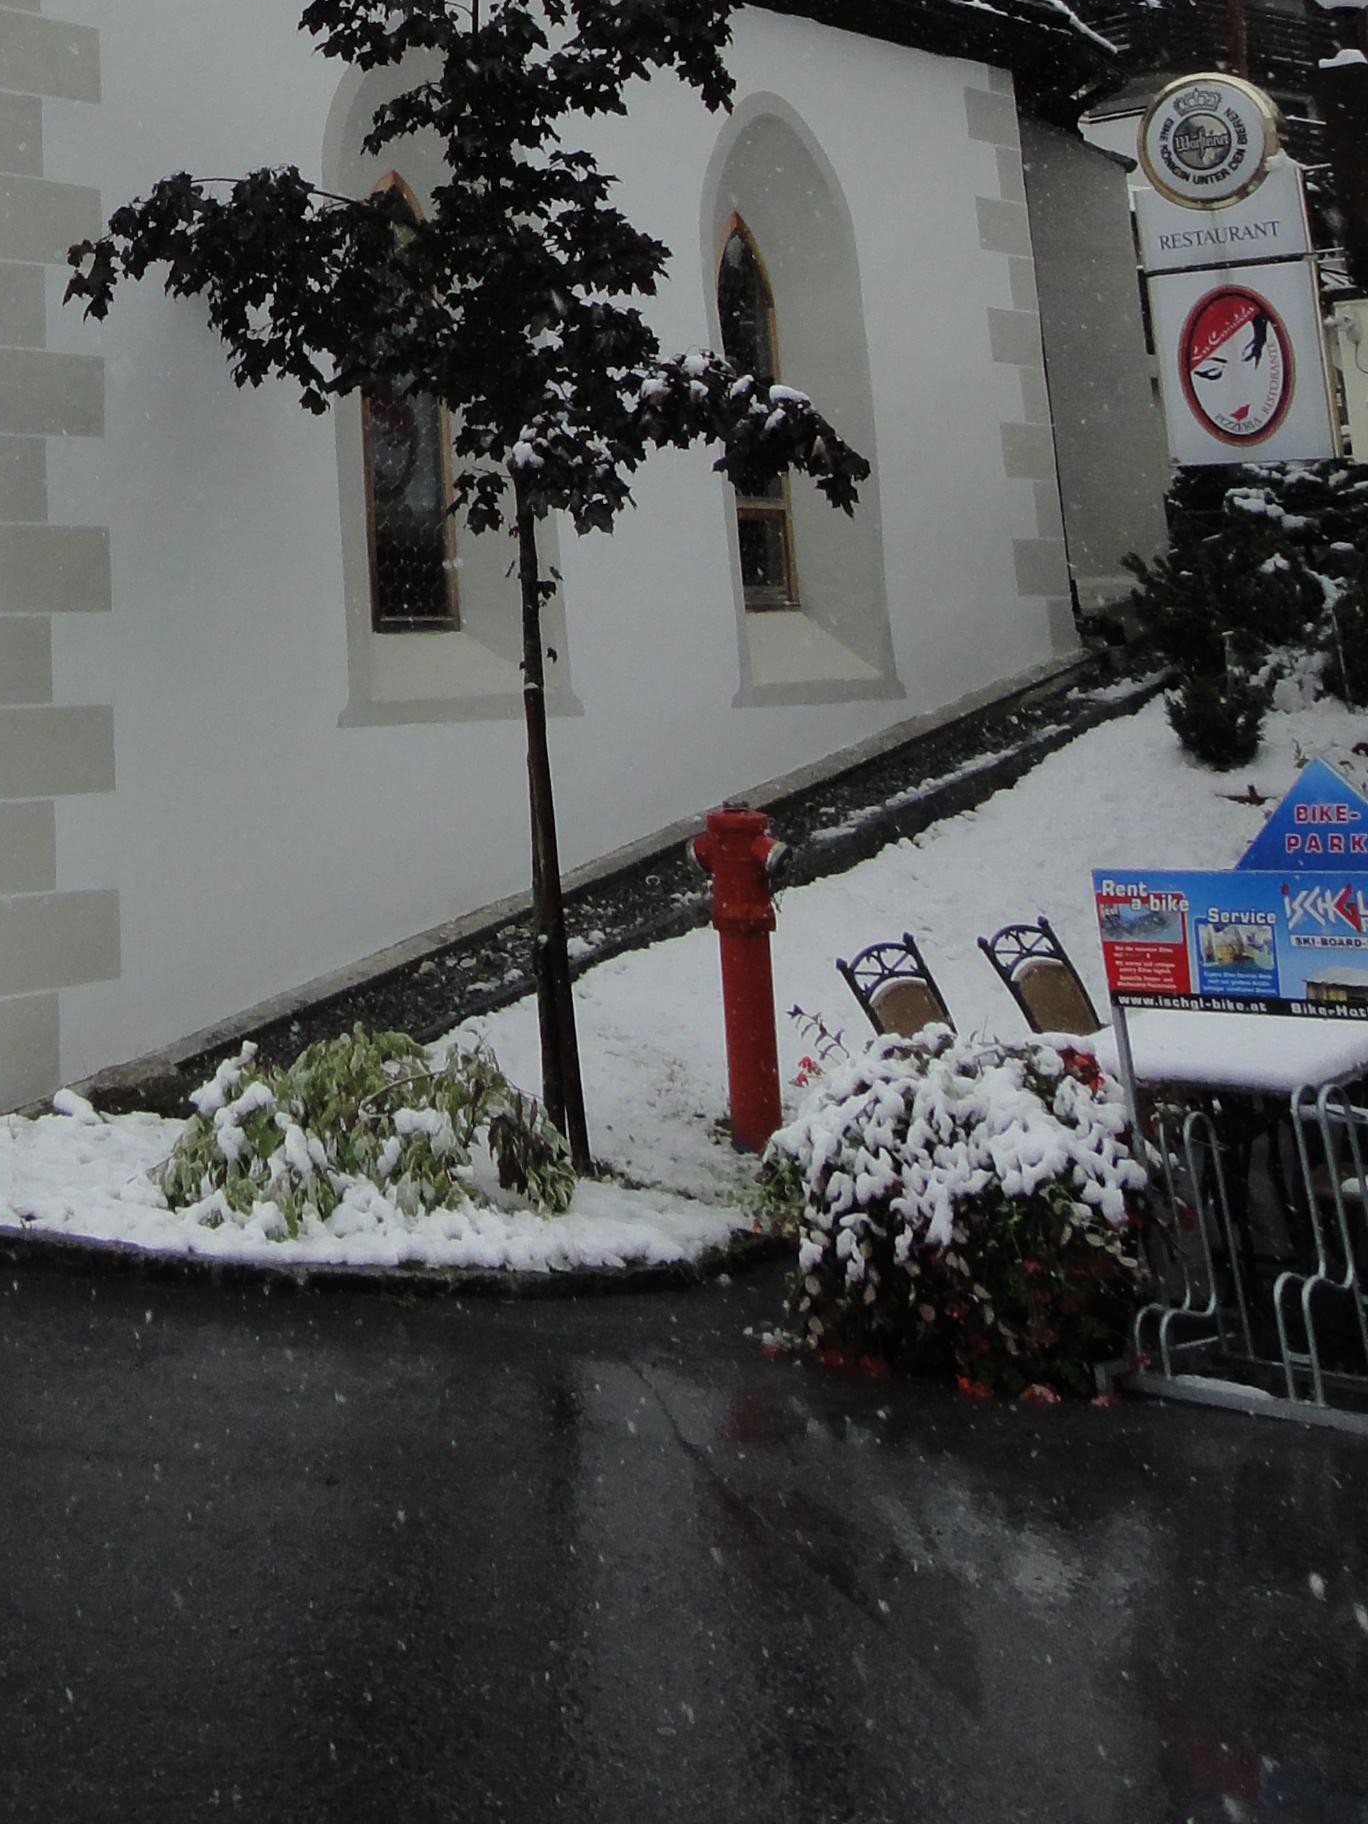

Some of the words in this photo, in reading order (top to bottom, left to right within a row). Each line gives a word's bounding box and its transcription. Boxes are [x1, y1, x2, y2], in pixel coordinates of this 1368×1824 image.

[1159, 117, 1174, 142] EINE
[1224, 107, 1248, 145] BIEREN
[1160, 144, 1191, 182] KÖNIGIN
[1228, 148, 1247, 171] DEN
[1192, 169, 1230, 184] UNTER
[1159, 220, 1280, 251] RESTAURANT
[1215, 412, 1262, 433] PIZZERIA
[1261, 343, 1279, 415] RISTORANTE
[1294, 803, 1362, 824] BIKE-
[1285, 833, 1368, 853] PARK
[1102, 879, 1148, 897] Rent
[1132, 897, 1141, 911] a
[1150, 894, 1189, 912] bike
[1207, 907, 1277, 924] Service
[1118, 995, 1267, 1013] www.ischgl-bike.at
